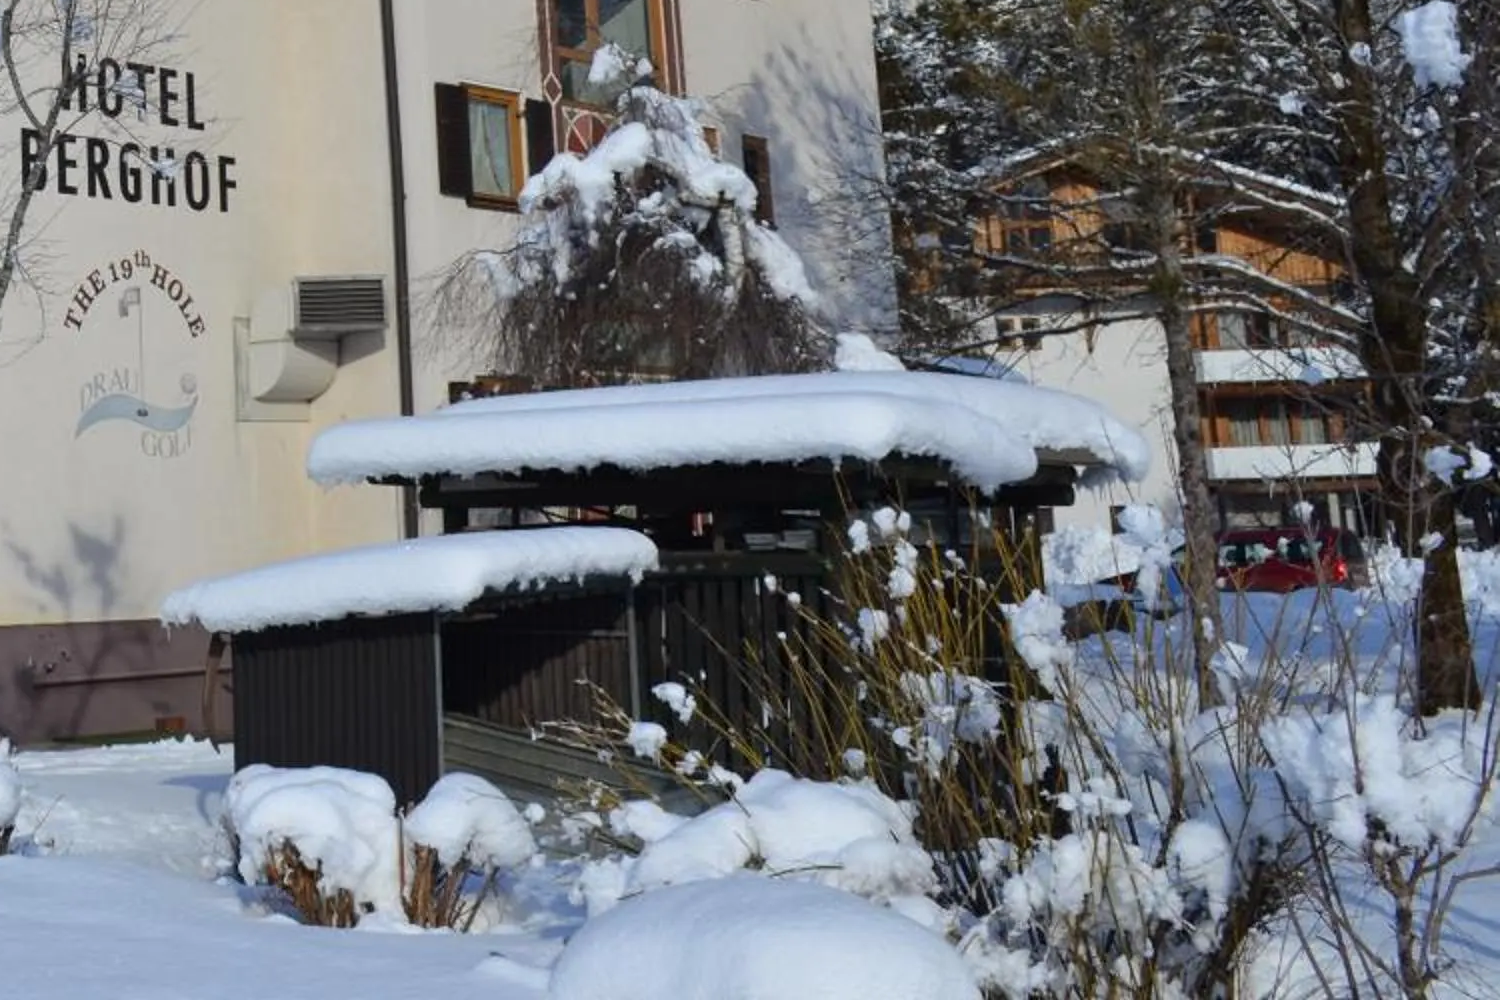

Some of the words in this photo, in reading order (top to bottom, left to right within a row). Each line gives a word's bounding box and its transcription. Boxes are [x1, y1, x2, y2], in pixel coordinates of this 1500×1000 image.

[62, 53, 205, 130] HOTEL
[21, 128, 236, 213] BERGHOF
[63, 268, 107, 332] THE
[108, 249, 151, 284] 19th
[150, 263, 206, 338] HOLE
